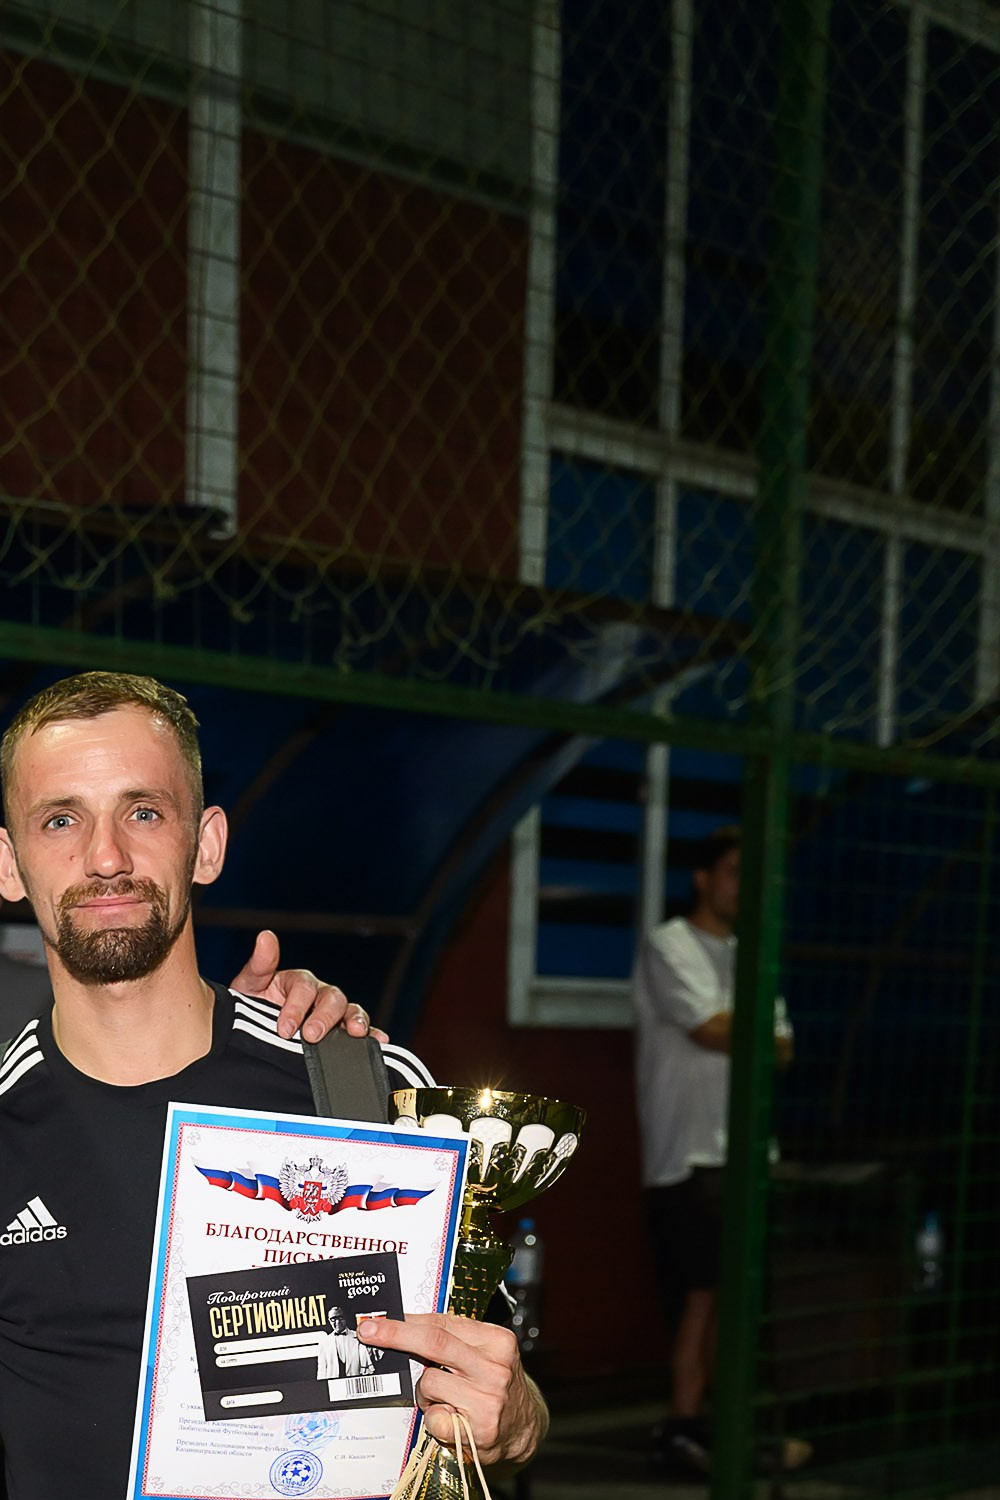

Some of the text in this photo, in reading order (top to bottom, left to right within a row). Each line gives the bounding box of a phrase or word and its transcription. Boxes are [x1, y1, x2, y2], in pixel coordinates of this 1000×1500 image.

[0, 1226, 68, 1246] adidas
[205, 1222, 409, 1255] БЛАГОДАРСТВЕННОЕ
[263, 1249, 344, 1265] ПИСЬ
[206, 1285, 291, 1305] Подарочный
[209, 1294, 327, 1339] СЕРТИФИКАТ
